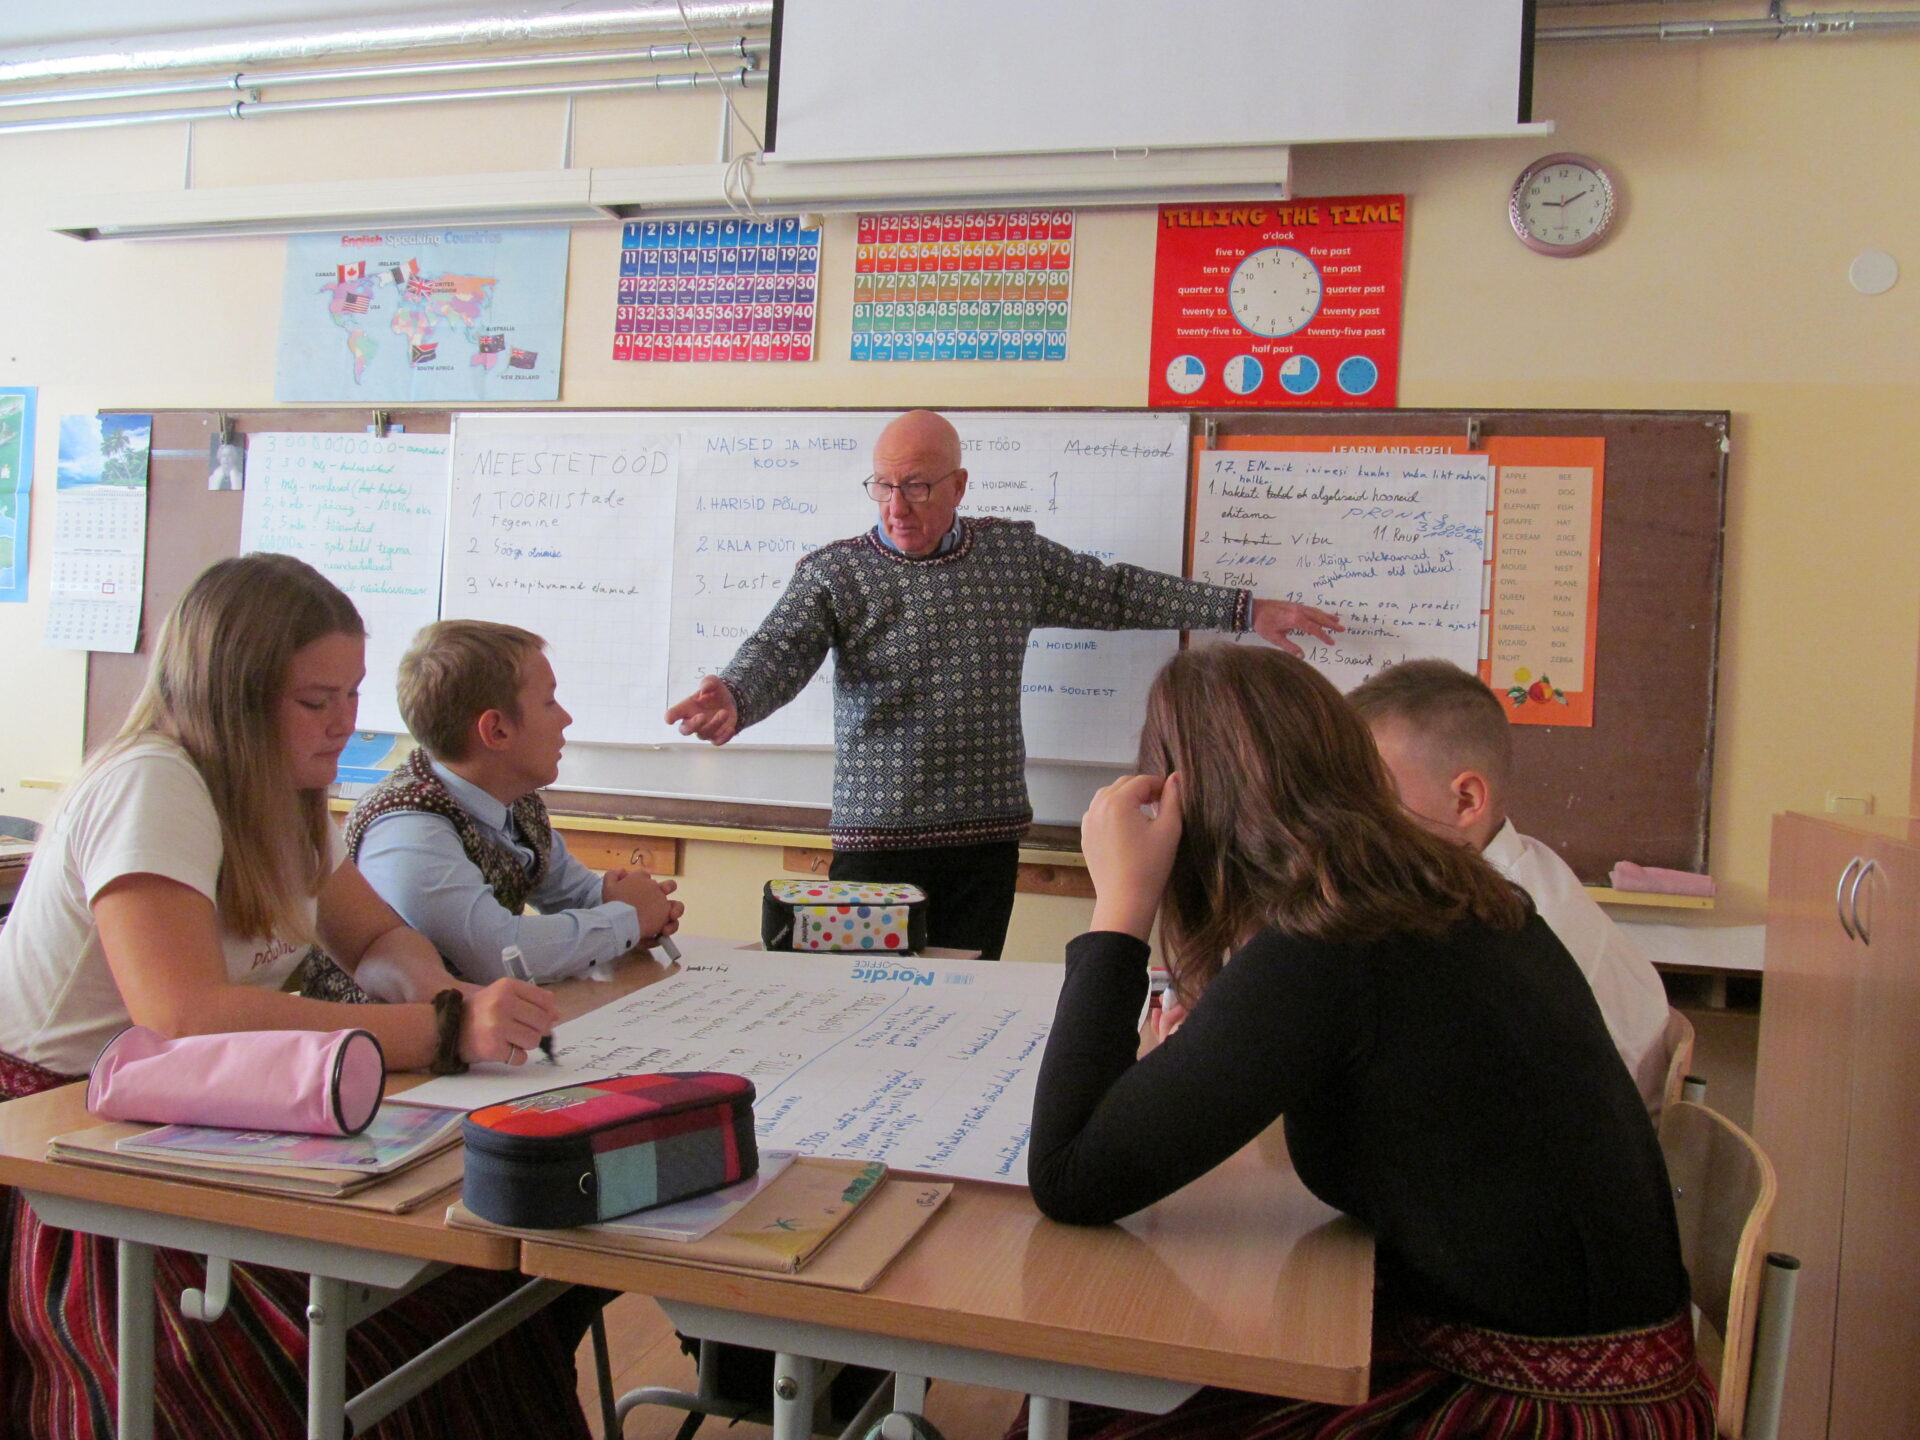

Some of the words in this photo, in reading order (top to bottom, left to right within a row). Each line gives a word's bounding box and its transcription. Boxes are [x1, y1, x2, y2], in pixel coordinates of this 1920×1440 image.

[1163, 209, 1268, 229] TELLING
[1278, 208, 1320, 226] THE
[1329, 203, 1401, 225] TIME
[861, 218, 876, 230] 51
[882, 218, 898, 229] 52
[902, 217, 919, 229] 53
[923, 216, 941, 228] 54
[944, 216, 962, 227] 55
[965, 215, 984, 227] 56
[986, 215, 1005, 227] 57
[1008, 214, 1027, 226] 58
[1031, 214, 1049, 226] 59
[1052, 213, 1071, 225] 60
[341, 235, 383, 247] English
[386, 234, 441, 247] Speaking
[444, 232, 502, 243] Countries
[1263, 232, 1294, 240] o'clock
[625, 252, 636, 264] 11
[644, 252, 657, 263] 12
[663, 251, 676, 263] 13
[683, 250, 696, 263] 14
[702, 250, 716, 262] 15
[722, 249, 735, 261] 16
[741, 249, 755, 261] 17
[761, 249, 775, 261] 18
[781, 248, 796, 260] 19
[799, 247, 816, 260] 20
[1216, 248, 1232, 256] five
[1310, 247, 1328, 255] five
[1331, 248, 1350, 257] past
[1341, 265, 1361, 274] past
[1178, 286, 1212, 295] quarter
[1326, 286, 1361, 294] quarter
[1365, 286, 1384, 294] past
[618, 307, 633, 319] 31
[637, 307, 654, 319] 32
[657, 307, 674, 319] 33
[676, 307, 693, 319] 34
[696, 306, 713, 319] 35
[715, 306, 732, 319] 36
[735, 306, 752, 319] 37
[755, 306, 772, 318] 38
[775, 305, 792, 318] 39
[795, 305, 812, 318] 40
[1182, 308, 1214, 316] twenty
[1323, 307, 1356, 316] twenty
[1359, 308, 1380, 316] past
[1177, 328, 1230, 336] twenty-five
[1308, 328, 1361, 337] twenty-five
[1365, 328, 1385, 337] past
[853, 335, 869, 347] 91
[874, 334, 891, 346] 92
[894, 334, 912, 346] 93
[916, 334, 934, 346] 94
[936, 333, 955, 346] 95
[958, 333, 977, 345] 96
[979, 333, 998, 345] 97
[1002, 333, 1021, 345] 98
[1024, 332, 1043, 345] 99
[1048, 332, 1065, 345] 100
[1252, 345, 1270, 353] half
[1273, 345, 1293, 354] past
[707, 437, 773, 454] NAISED
[786, 439, 800, 450] JA
[808, 438, 858, 450] MEHED
[1381, 446, 1411, 454] AND
[753, 457, 800, 468] KOOS
[717, 539, 752, 551] KALA
[854, 960, 890, 969] OFFICE
[851, 969, 935, 986] Nordic
